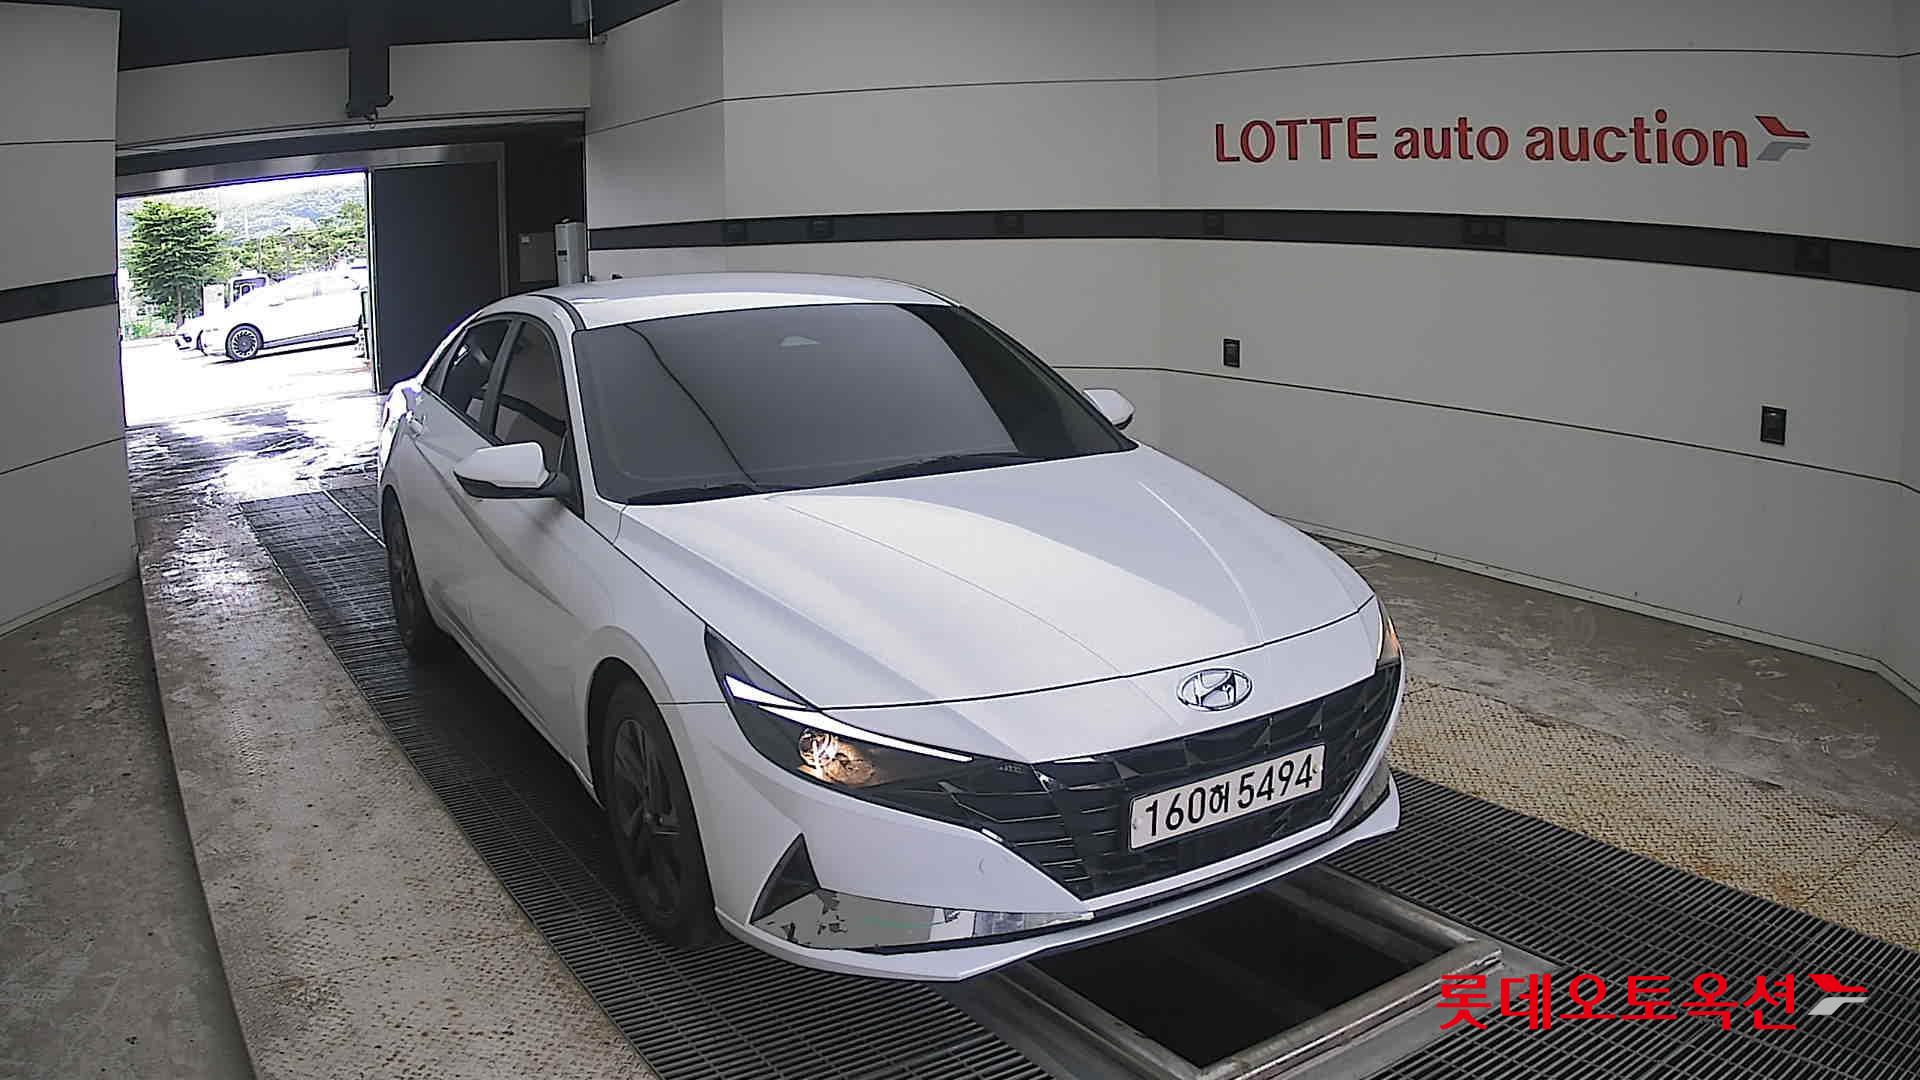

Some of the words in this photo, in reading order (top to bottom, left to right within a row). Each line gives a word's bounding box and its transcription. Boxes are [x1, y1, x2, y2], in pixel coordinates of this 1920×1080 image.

[1215, 116, 1378, 163] LOTTE
[1393, 116, 1509, 161] auto
[1525, 108, 1749, 168] auction
[1237, 754, 1312, 809] 5494
